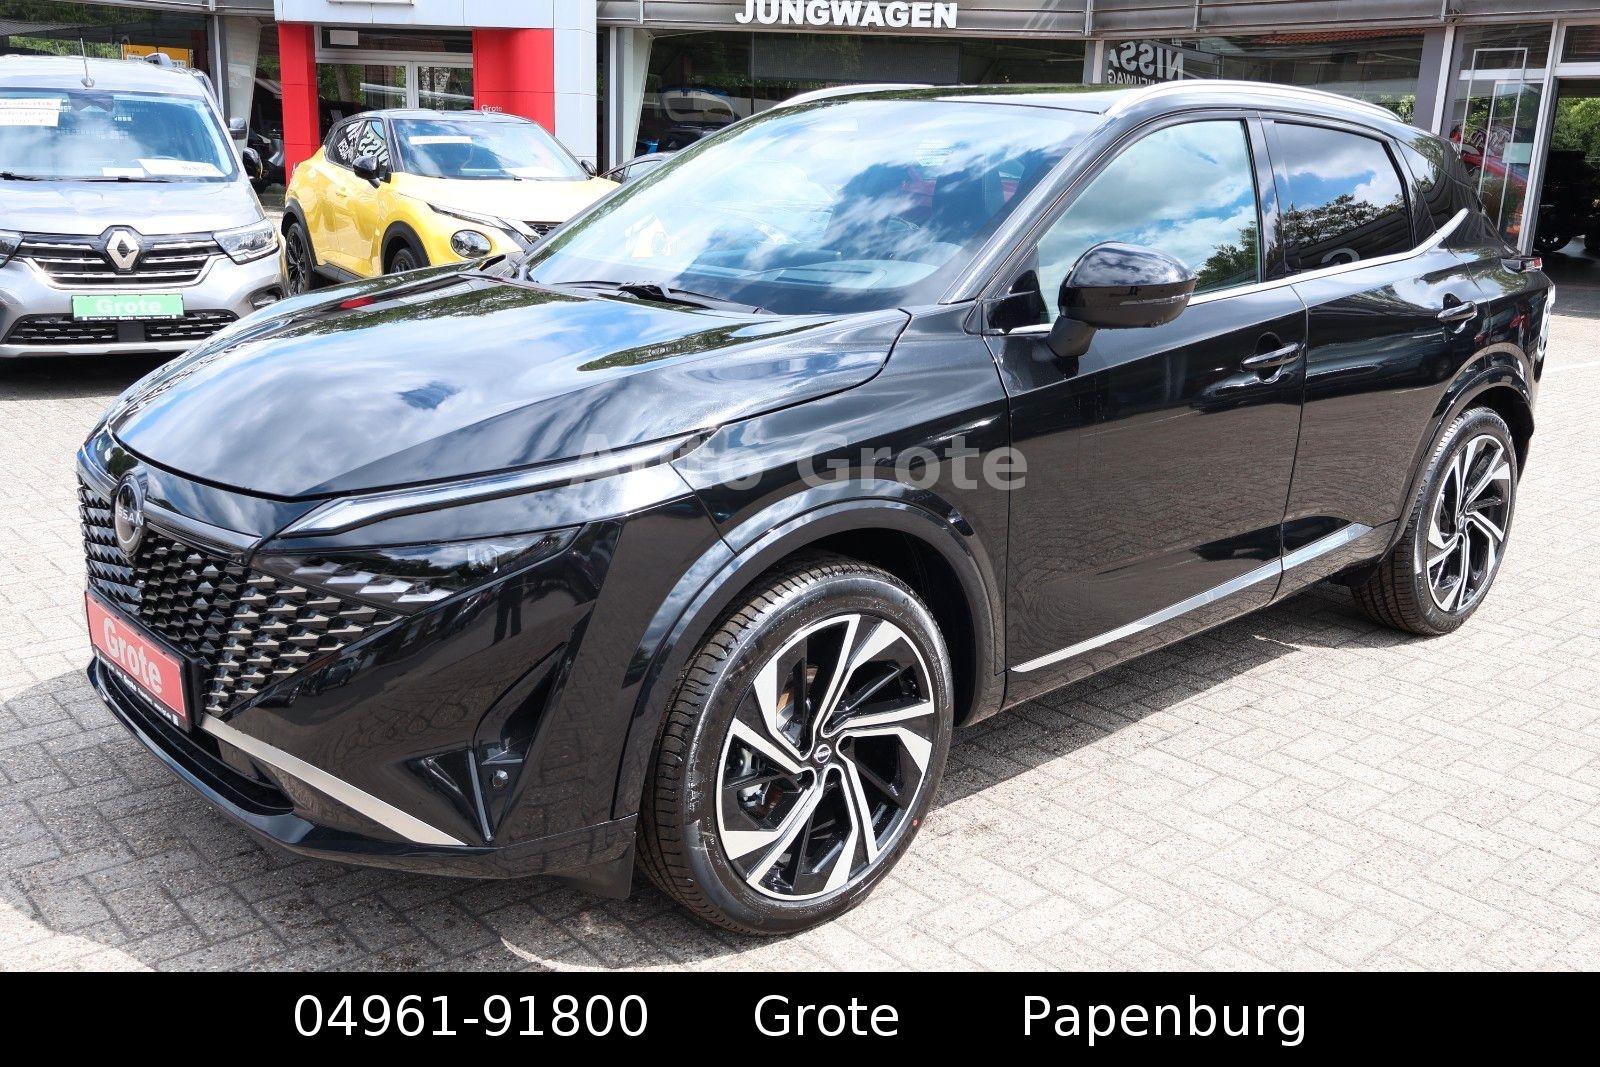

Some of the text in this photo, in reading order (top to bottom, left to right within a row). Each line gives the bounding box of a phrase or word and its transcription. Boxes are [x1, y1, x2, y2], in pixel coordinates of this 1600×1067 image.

[735, 0, 957, 29] JUNGWAGEN
[96, 299, 162, 313] Grote
[103, 617, 162, 693] Grote
